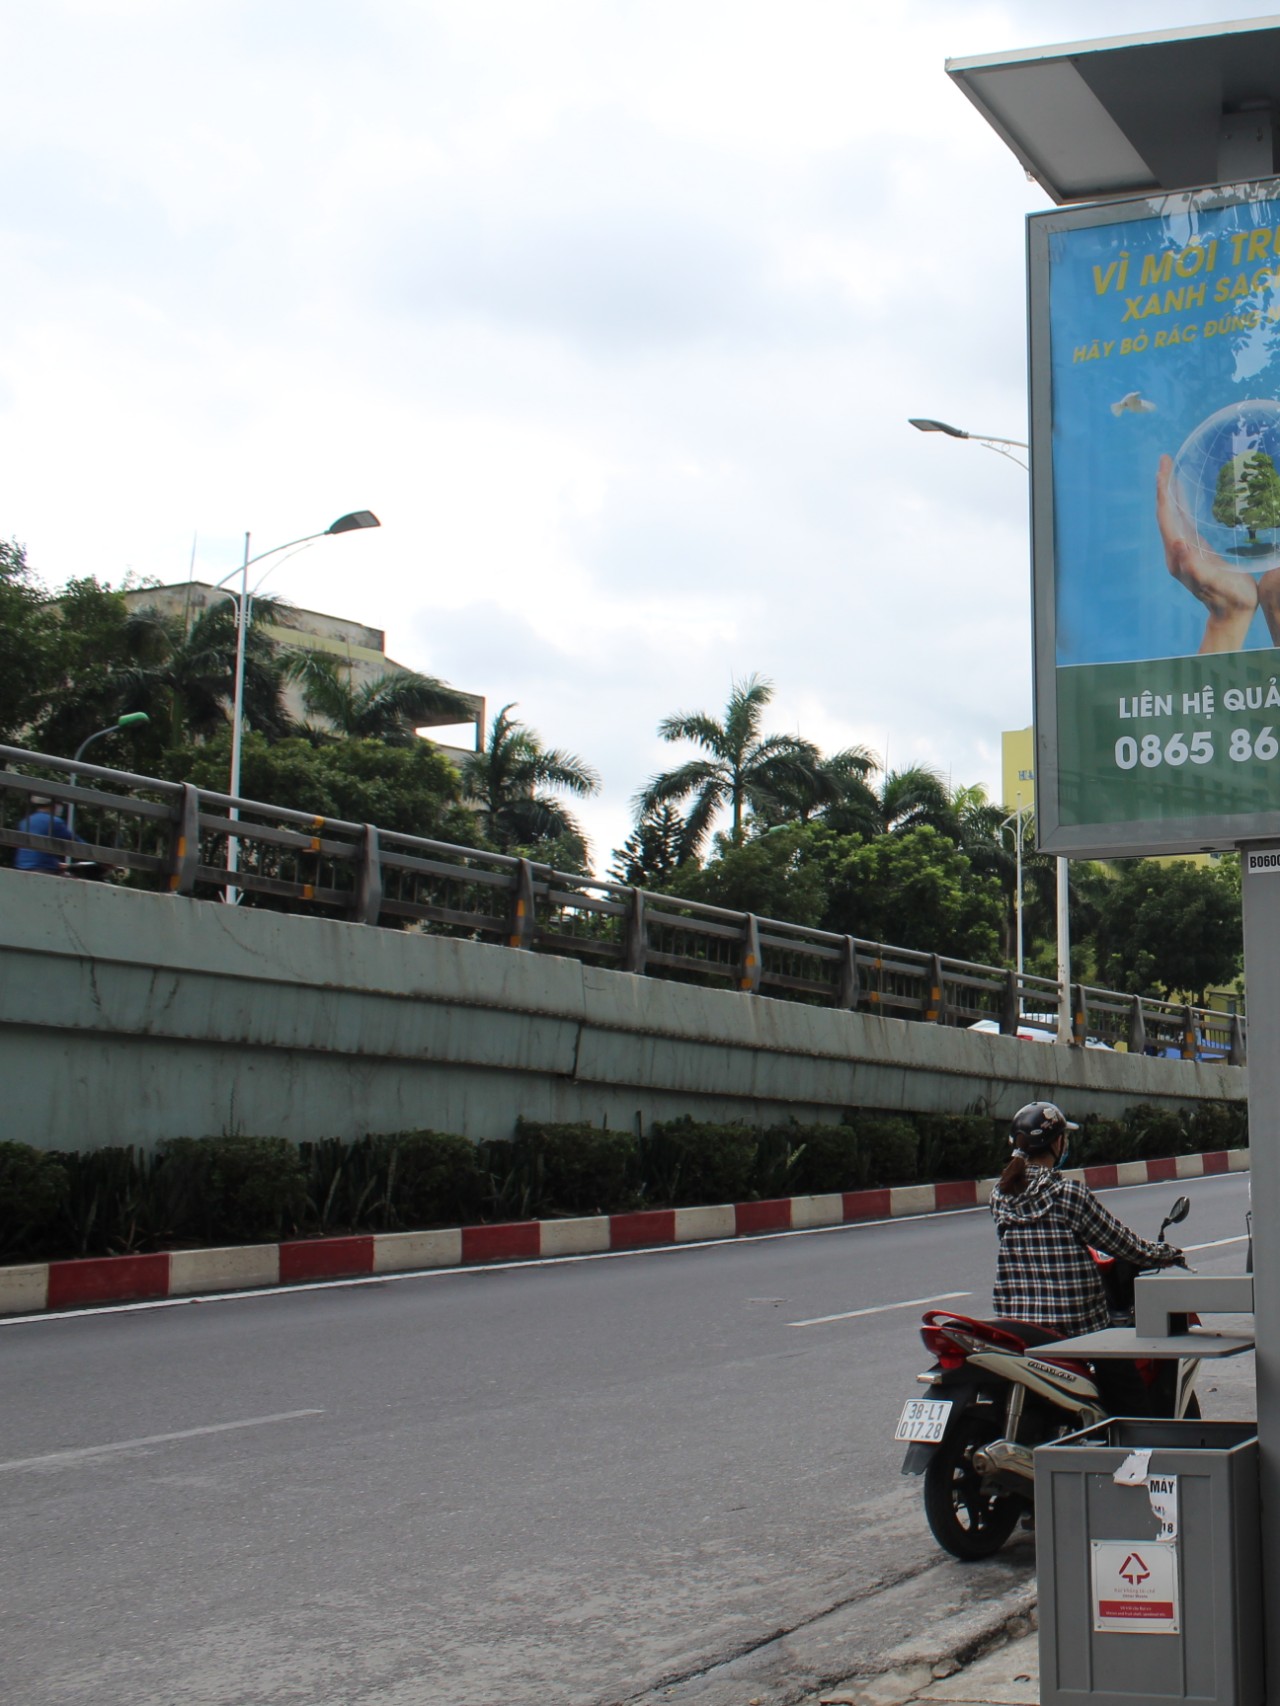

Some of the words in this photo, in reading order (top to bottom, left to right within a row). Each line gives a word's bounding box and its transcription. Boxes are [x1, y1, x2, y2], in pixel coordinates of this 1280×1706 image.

[1092, 251, 1130, 295] VÌ
[1140, 235, 1217, 287] MÔI
[1121, 282, 1206, 322] XANH
[1073, 338, 1115, 363] HÃY
[1120, 328, 1148, 355] BỎ
[1154, 323, 1197, 348] RÁC
[1204, 309, 1260, 338] ĐÚNG
[1120, 690, 1172, 719] LIÊN
[1183, 685, 1214, 719] HỆ
[1115, 731, 1214, 770] 0865
[1229, 726, 1279, 762] 86
[909, 1403, 945, 1420] 38-L1
[899, 1422, 943, 1439] 017.28
[1150, 1478, 1174, 1494] MÁY
